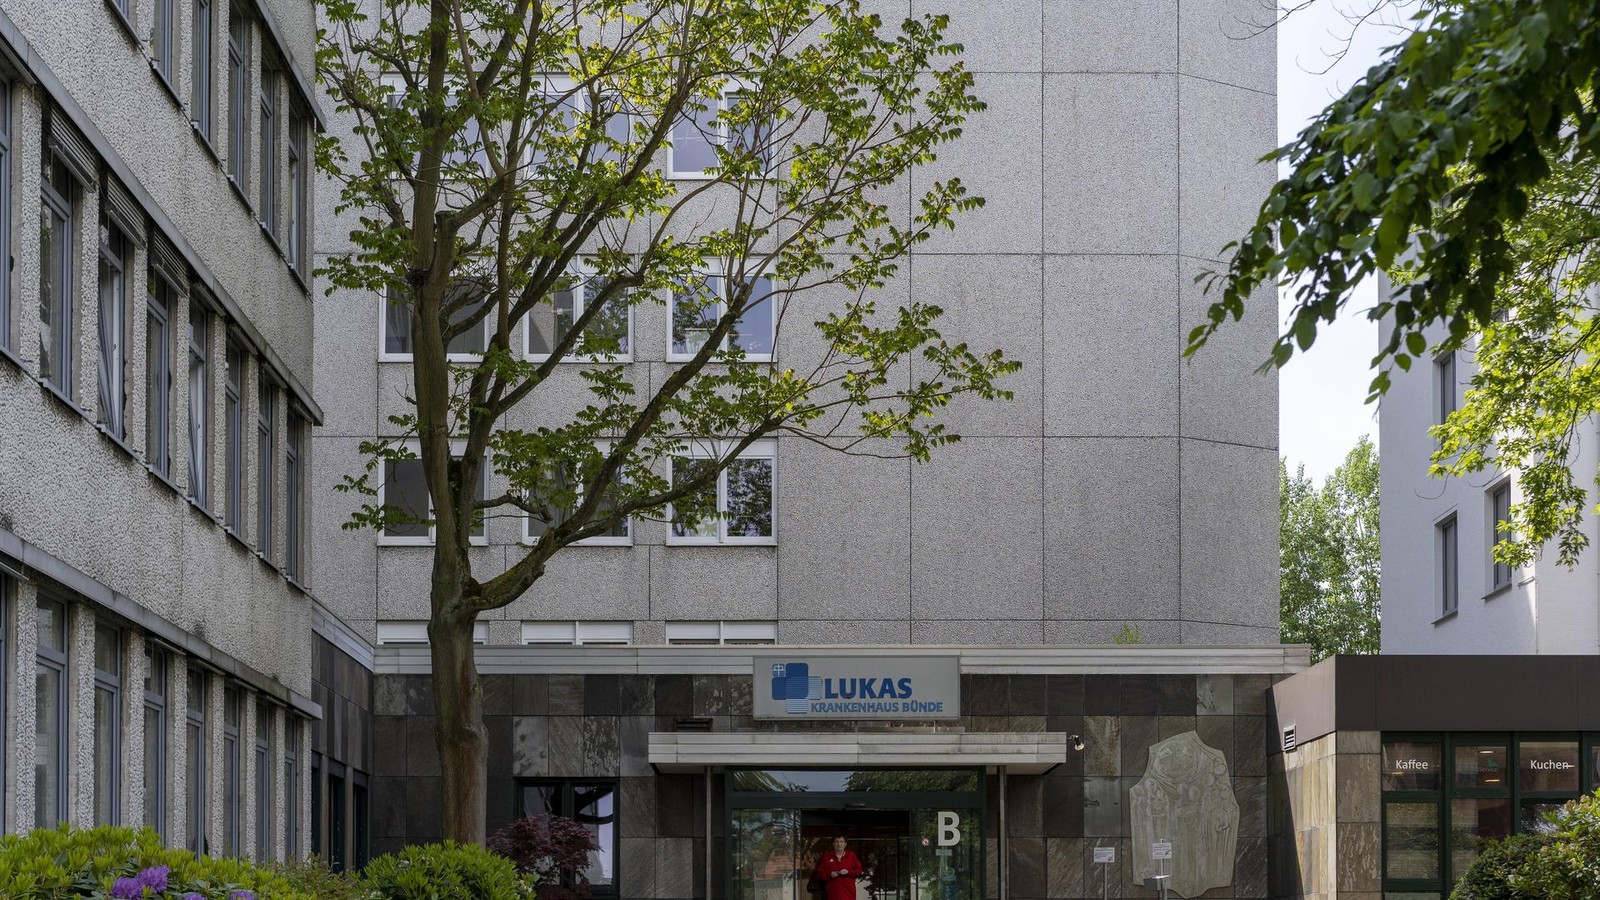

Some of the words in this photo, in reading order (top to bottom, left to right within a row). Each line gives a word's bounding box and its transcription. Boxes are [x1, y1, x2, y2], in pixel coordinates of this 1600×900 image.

[825, 678, 912, 699] LUKAS
[811, 702, 899, 713] KRANKENHAUS
[902, 700, 943, 713] BÜNDE
[1395, 759, 1429, 770] Kaffee
[1530, 759, 1569, 770] Kuchen
[937, 811, 961, 846] B
